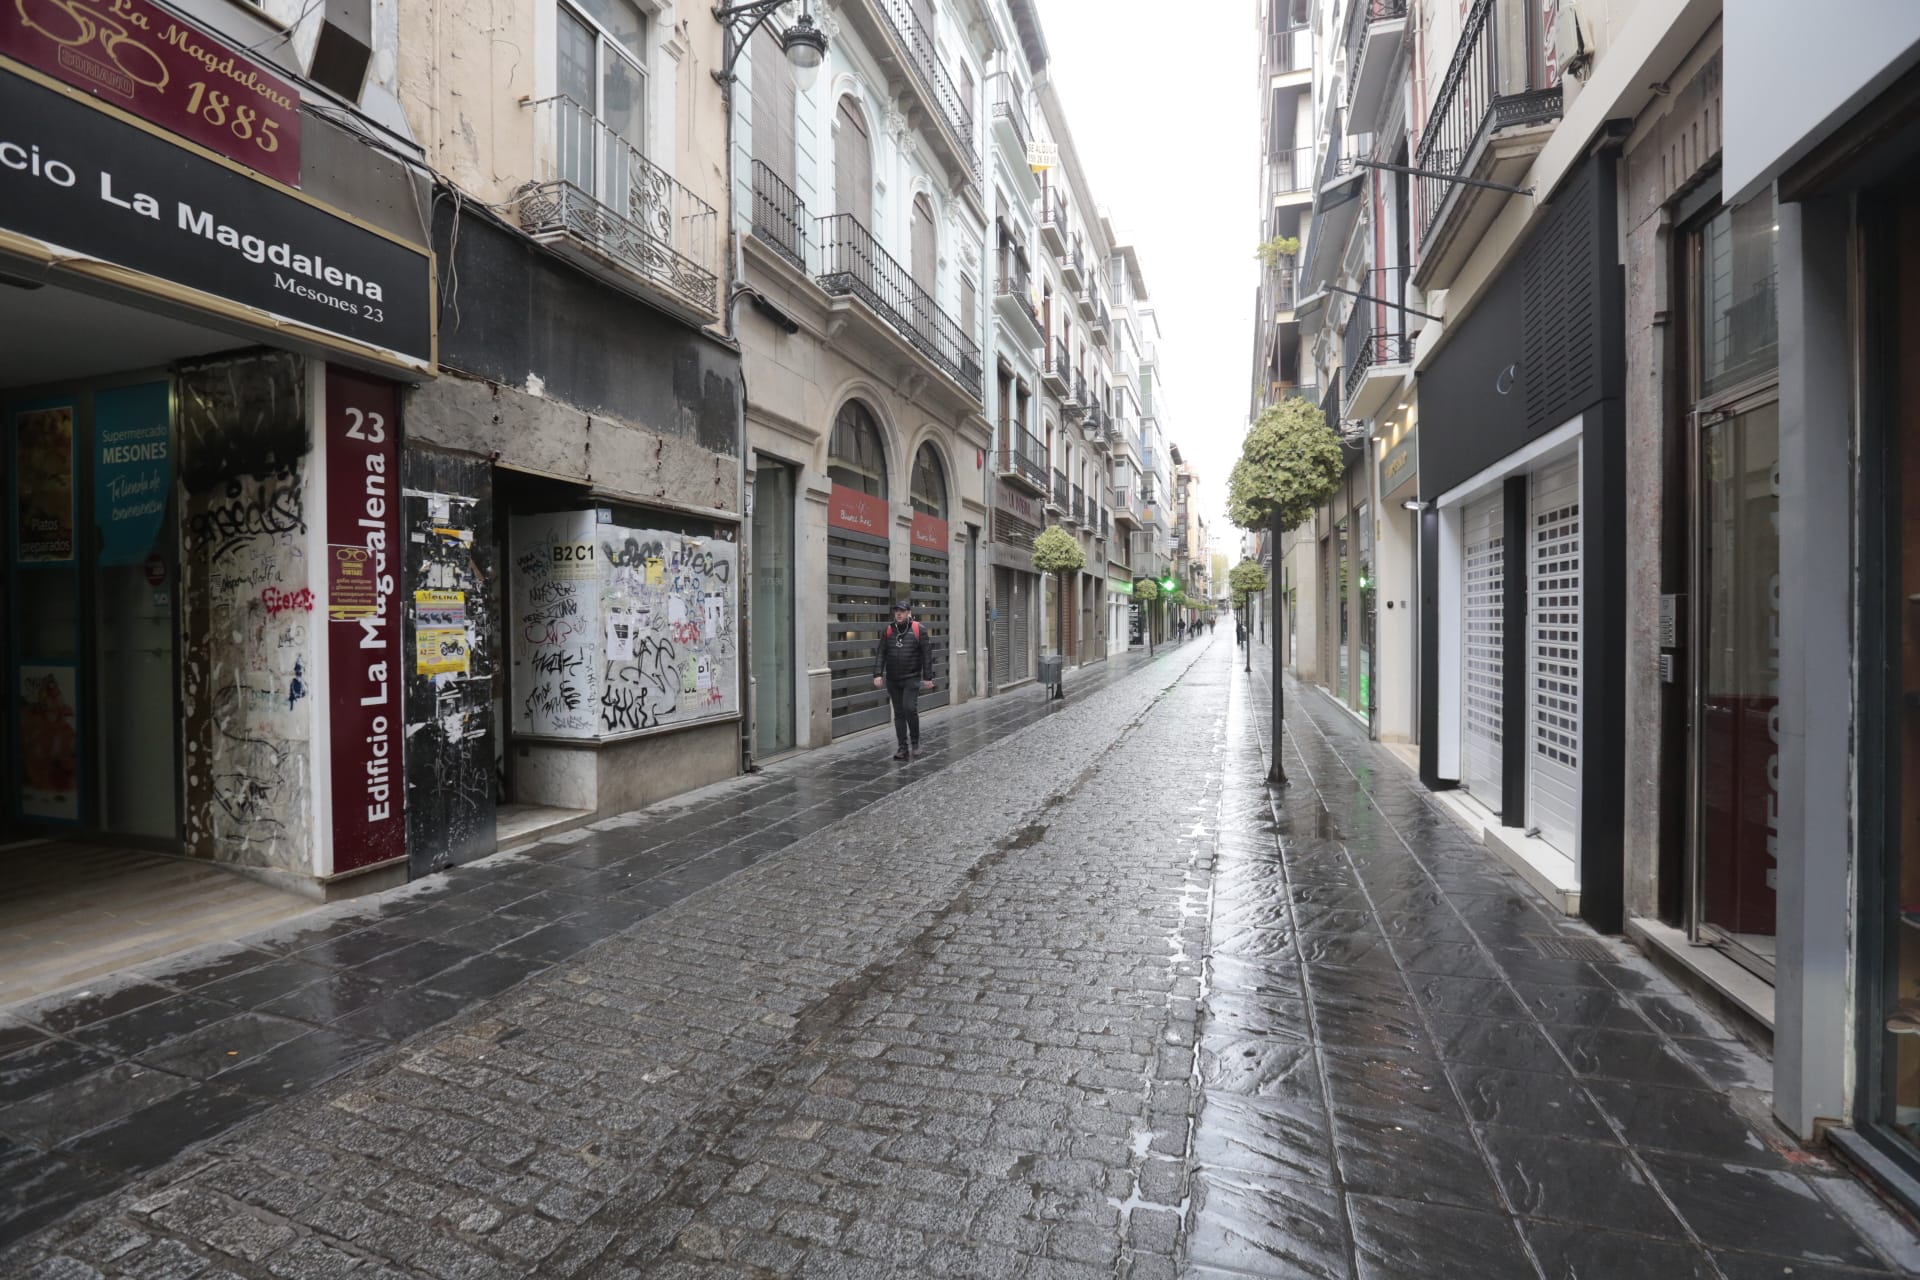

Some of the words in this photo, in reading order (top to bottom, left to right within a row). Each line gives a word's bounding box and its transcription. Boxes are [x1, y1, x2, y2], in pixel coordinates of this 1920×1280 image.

[109, 0, 150, 30] La
[158, 24, 293, 111] Magdalena
[187, 81, 280, 153] 1885
[0, 142, 76, 188] cio
[101, 171, 161, 220] La
[178, 201, 383, 302] Magdalena
[274, 272, 359, 315] Mesones
[363, 305, 384, 323] 23
[102, 424, 168, 444] Supermercado
[345, 408, 385, 443] 23
[102, 442, 167, 465] MESONES
[553, 546, 573, 561] B2
[576, 545, 594, 560] C1
[360, 660, 389, 706] La
[366, 716, 390, 822] Edificio
